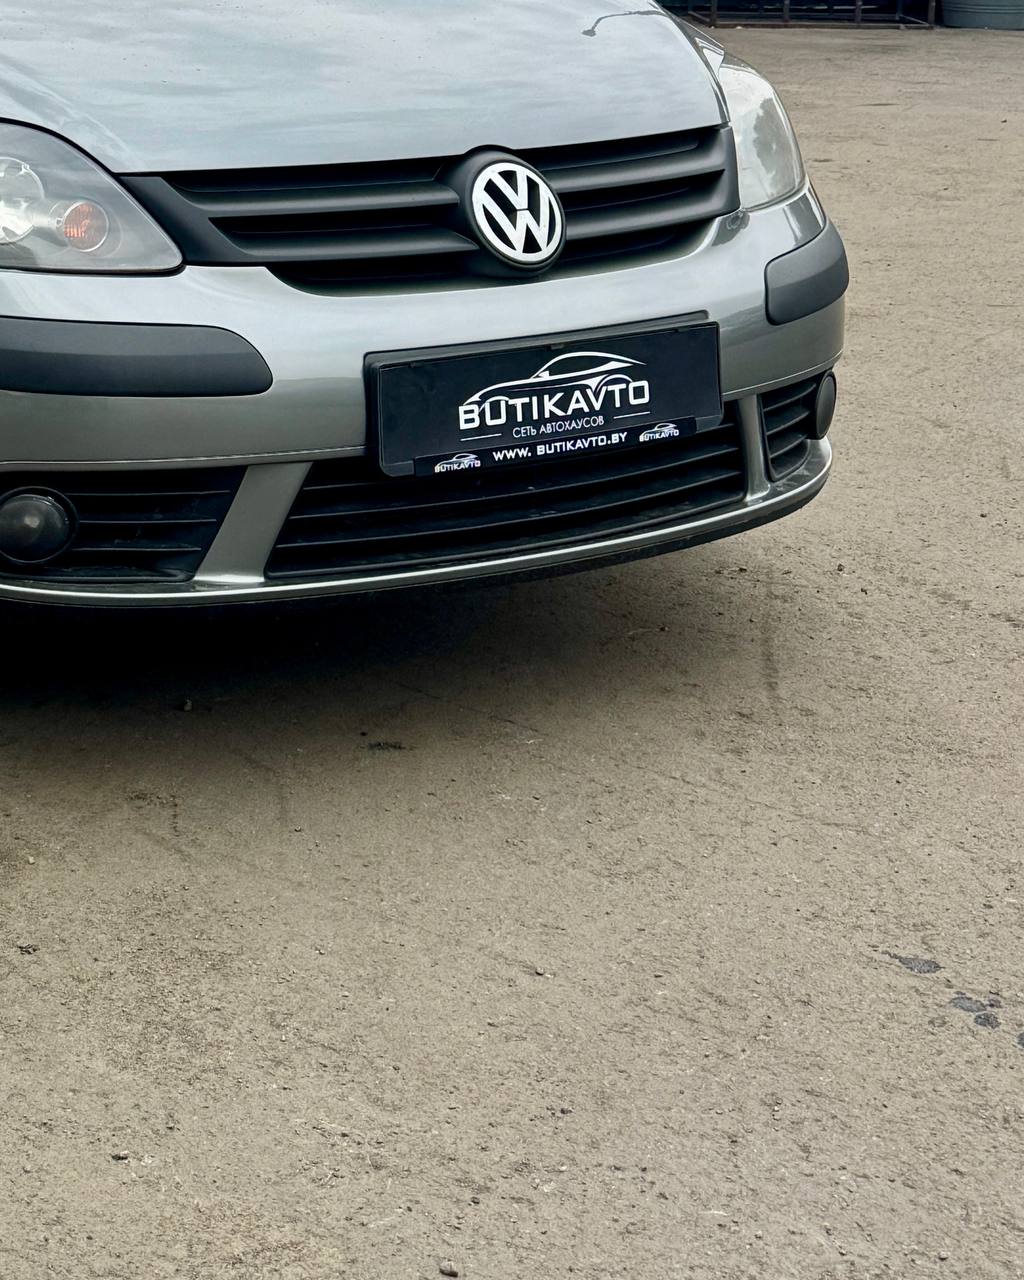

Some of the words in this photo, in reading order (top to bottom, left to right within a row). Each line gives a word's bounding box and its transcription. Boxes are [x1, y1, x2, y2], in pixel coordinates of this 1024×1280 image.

[458, 380, 650, 430] BUTIKAVTO
[512, 424, 537, 439] СЕТЬ
[539, 415, 605, 435] АВТОХАУСОВ
[639, 428, 680, 442] BUTIKAVTO
[493, 447, 532, 462] WWW.
[536, 432, 628, 456] BUTIKAVTO.BY
[434, 460, 481, 473] BUTIKAVTO
